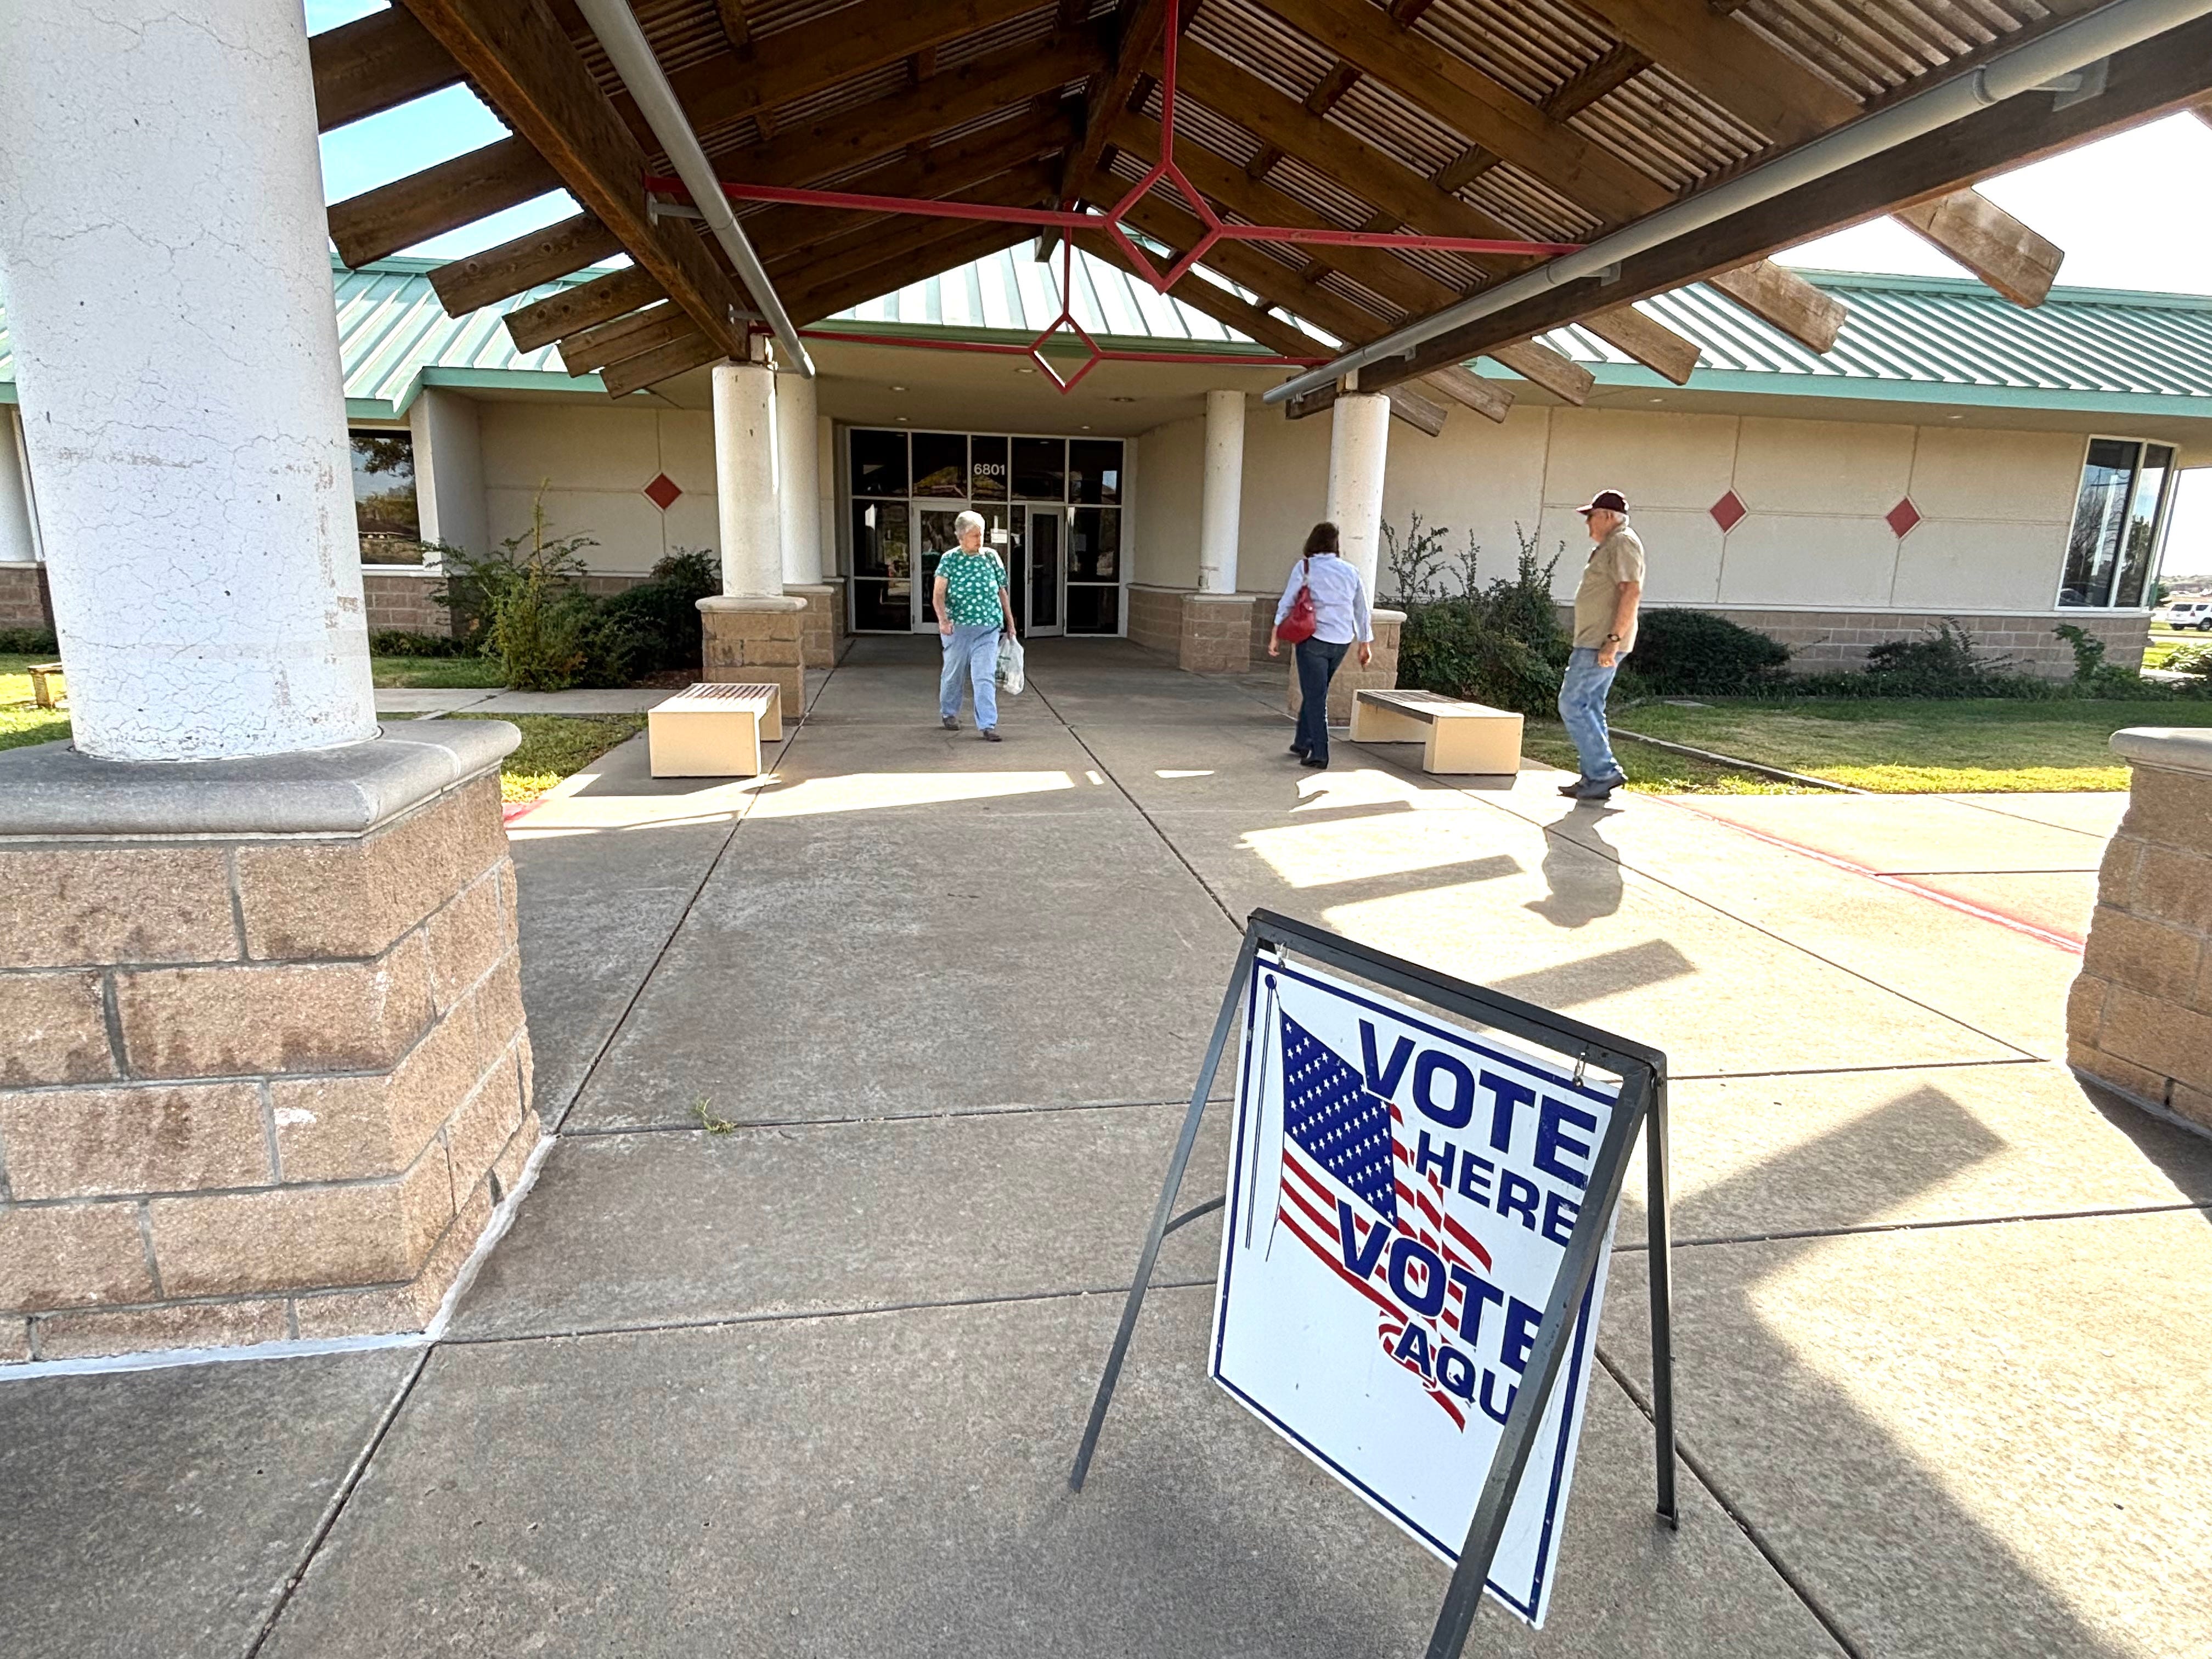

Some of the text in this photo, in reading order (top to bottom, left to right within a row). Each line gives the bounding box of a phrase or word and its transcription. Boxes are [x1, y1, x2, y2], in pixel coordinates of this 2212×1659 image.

[974, 464, 1005, 475] 6801
[1359, 1019, 1597, 1189] VOTE
[1416, 1130, 1579, 1246] HERE
[1337, 1200, 1544, 1374] VOTE
[1394, 1323, 1518, 1425] AQU
